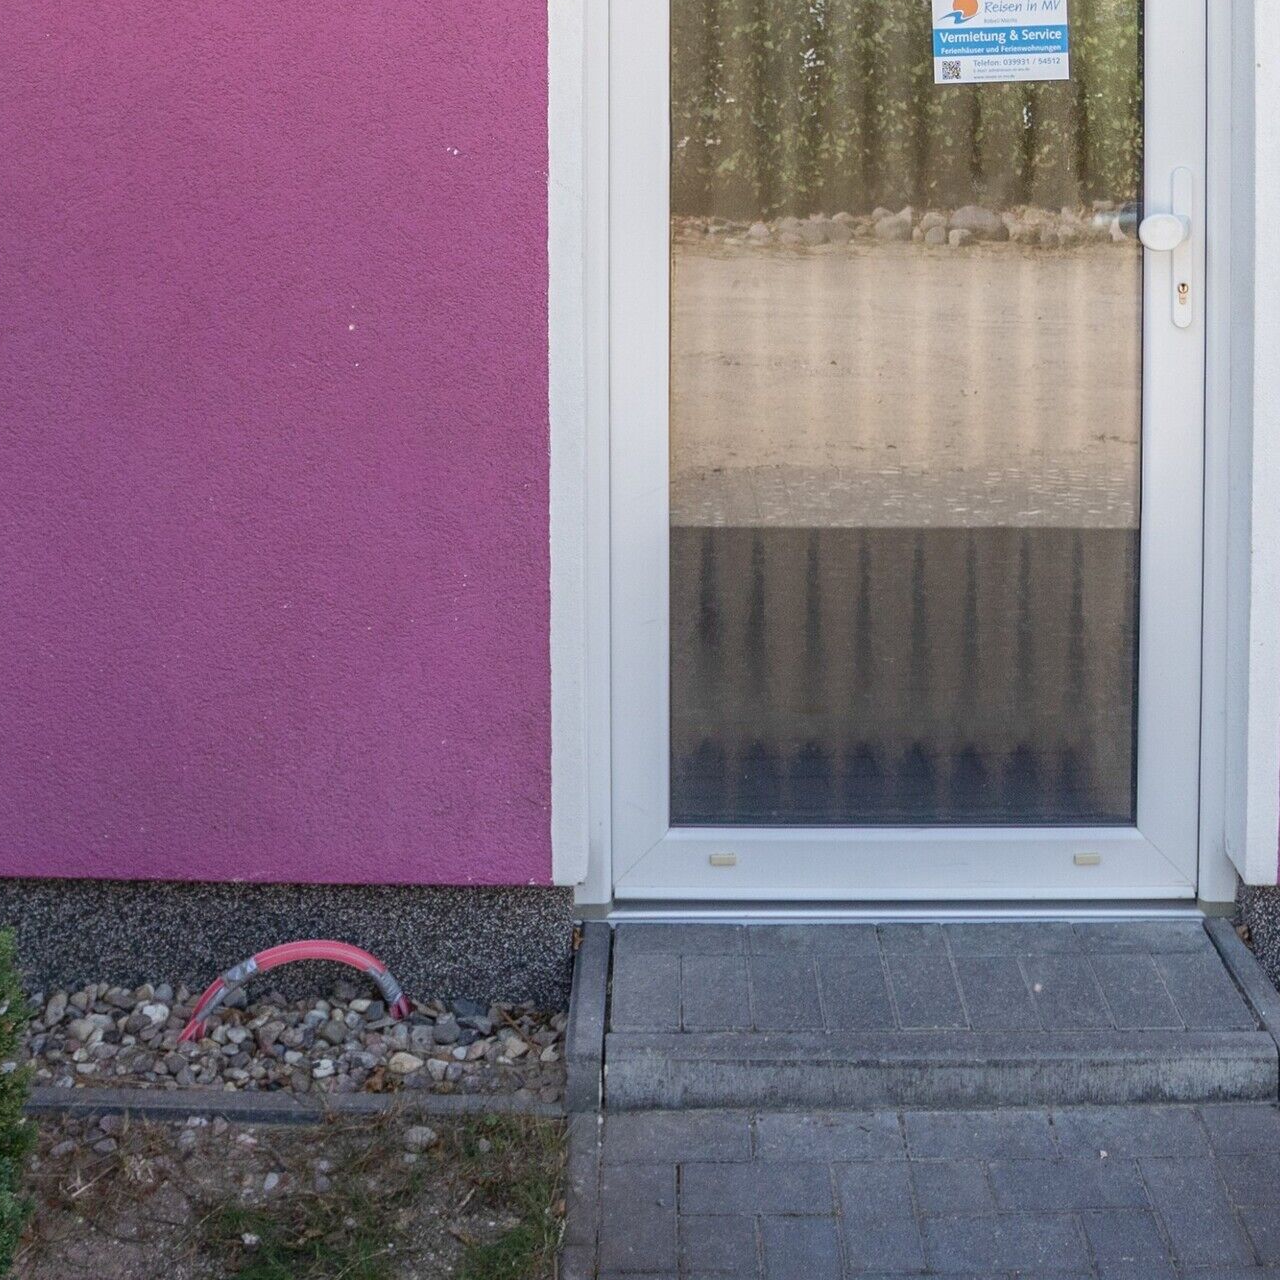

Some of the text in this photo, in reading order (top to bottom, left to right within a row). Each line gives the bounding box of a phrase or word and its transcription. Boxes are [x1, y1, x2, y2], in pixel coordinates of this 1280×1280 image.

[984, 0, 1061, 14] Reisen in MV
[939, 28, 1062, 44] Vermietung & Service
[940, 44, 1062, 55] Ferienhäuser und Ferienwohnungen
[973, 59, 1002, 67] Telefon:
[1002, 58, 1030, 66] 039931
[1038, 56, 1061, 65] 54512
